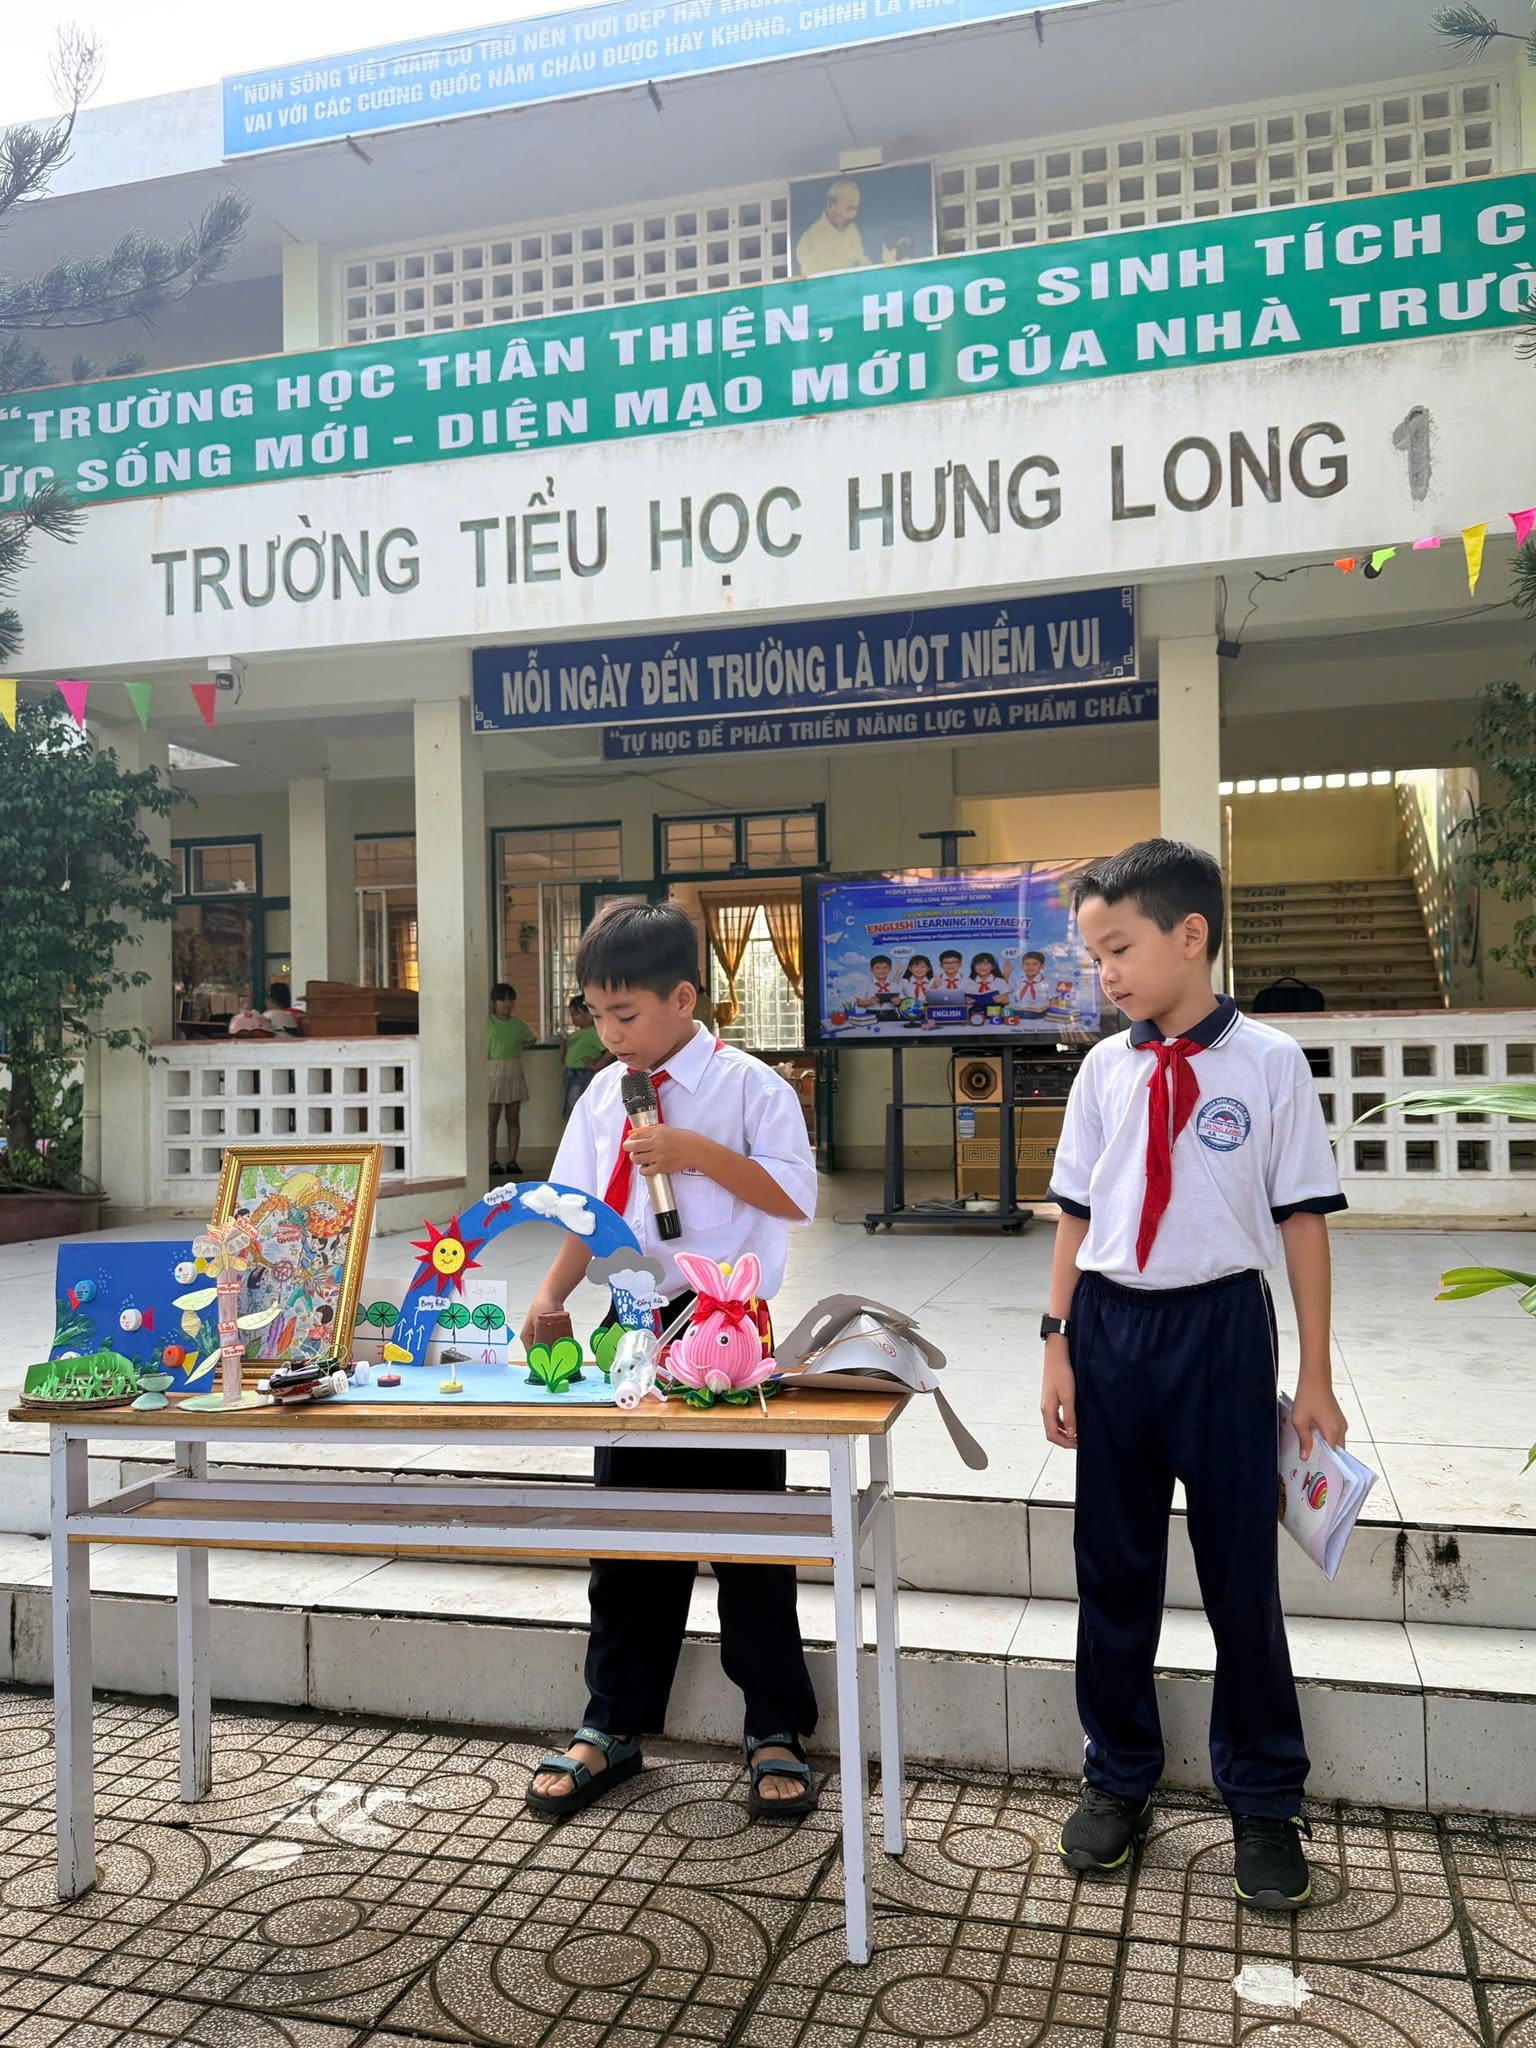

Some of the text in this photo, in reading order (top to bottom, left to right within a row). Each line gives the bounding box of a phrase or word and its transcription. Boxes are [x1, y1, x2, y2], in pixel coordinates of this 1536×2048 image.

[244, 111, 273, 134] VAI
[278, 102, 308, 128] VỚI
[313, 96, 352, 120] CÁC
[429, 67, 481, 100] QUỐC
[488, 62, 535, 89] NĂM
[541, 49, 596, 78] CHÂU
[603, 39, 659, 67] ĐƯỢC
[664, 30, 704, 56] HAY
[290, 69, 341, 96] SÔNG
[347, 58, 386, 85] VIỆT
[394, 51, 440, 76] NAM
[523, 26, 567, 53] NÊN
[573, 15, 618, 43] TƯƠI
[625, 8, 665, 35] ĐẸP
[0, 383, 253, 443] “TRƯỜNG
[276, 364, 395, 412] HỌC
[418, 336, 585, 391] THÂN
[609, 304, 833, 366] THIỆN,
[863, 277, 1006, 332] HỌC
[1037, 244, 1224, 306] SINH
[1254, 214, 1441, 276] TÍCH
[76, 442, 231, 493] SỐNG
[255, 423, 368, 471] MỚI
[393, 435, 413, 445] -
[438, 397, 588, 450] DIỆN
[614, 376, 762, 428] MẠO
[792, 349, 926, 406] MỚI
[957, 324, 1107, 383] CỦA
[1137, 297, 1300, 360] NHÀ
[151, 404, 1434, 616] TRƯỜNG TIỂU HỌC HƯNG LONG 1
[501, 649, 551, 716] MỖI
[559, 653, 631, 711] NGÀY
[641, 641, 699, 706] ĐẾN
[707, 637, 826, 700] TRƯỜNG
[835, 631, 874, 690] LÀ
[961, 610, 1036, 679] NIỀM
[1047, 617, 1100, 669] VUI
[609, 688, 1158, 755] “TỰ HỌC ĐỂ PHÁT TRIỂN NĂNG LỰC VÀ PHẨM CHẤT”
[867, 916, 1032, 934] ENGLISH LEARNING MOVEMENT
[932, 1010, 961, 1018] ENGLISH
[992, 1016, 1014, 1024] C C
